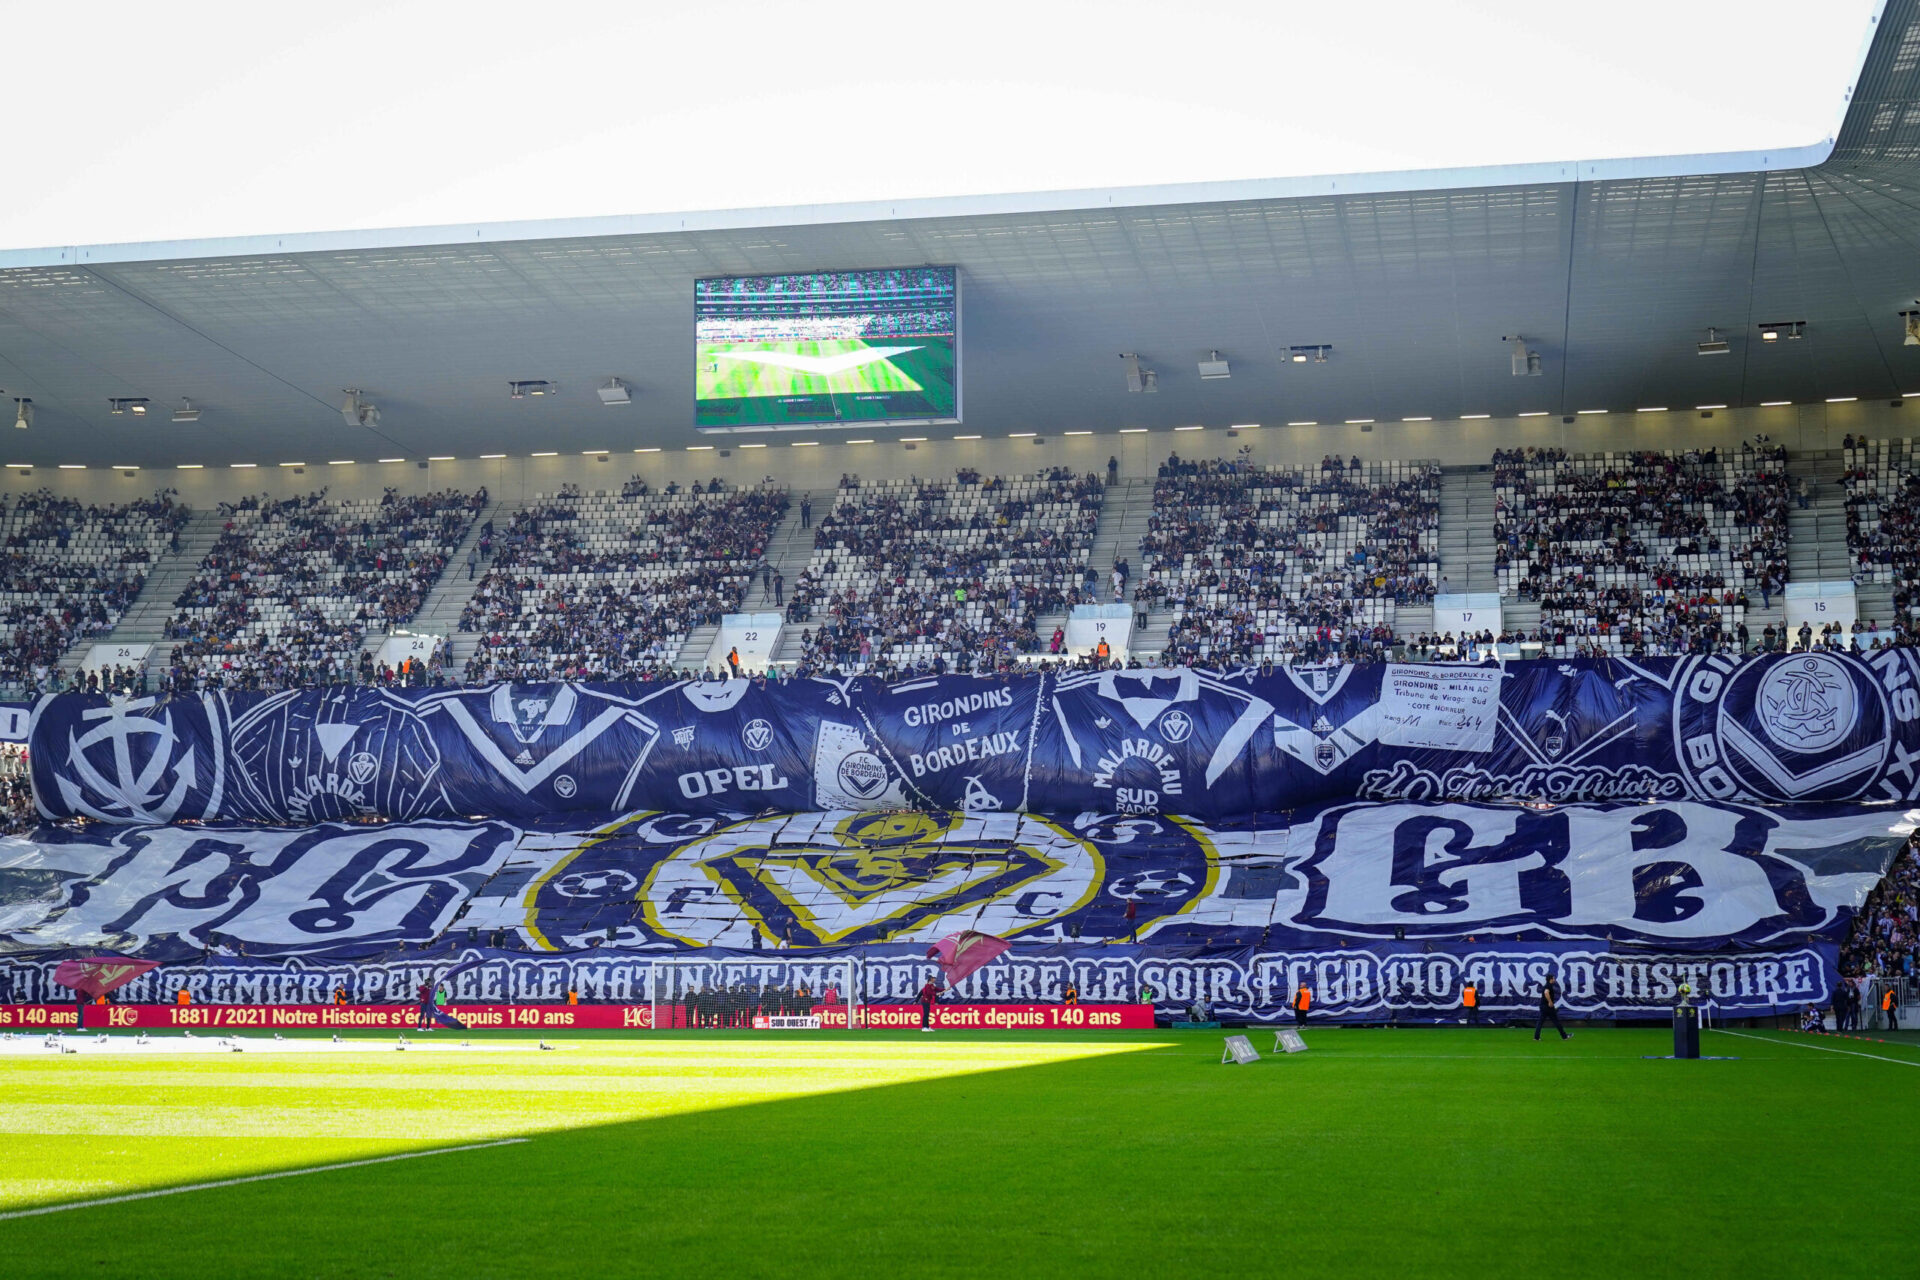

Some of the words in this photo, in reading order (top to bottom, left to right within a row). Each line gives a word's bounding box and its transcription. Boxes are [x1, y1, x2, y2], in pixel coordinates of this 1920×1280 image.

[1814, 602, 1826, 612] 15
[1462, 612, 1473, 622] 17
[1095, 622, 1106, 632] 19
[745, 632, 758, 641] 22
[411, 640, 424, 650] 24
[117, 647, 130, 657] 26
[1391, 668, 1430, 678] GIRONDINS
[1440, 672, 1479, 680] BORDEAUX
[1393, 680, 1439, 691] GIRONDINS
[1394, 688, 1425, 699] Tribune
[1471, 697, 1487, 705] Sud
[904, 686, 1013, 727] GIRONDINS
[952, 722, 971, 736] DE
[910, 730, 1021, 777] BORDEAUX
[845, 761, 883, 772] GIRONDINS
[1093, 738, 1183, 795] MALARDEAU
[841, 767, 850, 775] DE
[850, 769, 886, 780] BORDEAUX
[678, 763, 789, 799] OPEL
[287, 772, 379, 823] MALARDEA
[1116, 787, 1159, 806] SUD
[1115, 803, 1160, 815] RADIO
[163, 964, 350, 1005] PREMIÈRE
[362, 956, 503, 1002] PENSÉE
[516, 966, 564, 1001] LE
[576, 964, 707, 1001] MATIN
[725, 964, 780, 1000] ET
[791, 964, 850, 999] MA
[1077, 966, 1130, 1001] LE
[1252, 957, 1372, 1009] FCGB
[1384, 961, 1452, 998] 140
[1463, 960, 1551, 998] ANS
[1566, 956, 1814, 999] D'HISTOIRE
[16, 1007, 47, 1025] 140
[50, 1011, 79, 1025] ans
[170, 1008, 210, 1025] 1881
[213, 1008, 223, 1026] /
[226, 1008, 266, 1025] 2021
[272, 1008, 318, 1025] Notre
[322, 1007, 387, 1025] Histoire
[508, 1008, 539, 1025] 140
[543, 1012, 575, 1025] ans
[771, 1018, 785, 1027] SUD
[786, 1018, 819, 1027] OUEST.fr
[851, 1008, 919, 1025] Histoire
[987, 1007, 1045, 1029] depuis
[1050, 1008, 1084, 1025] 140
[1088, 1012, 1122, 1025] ans
